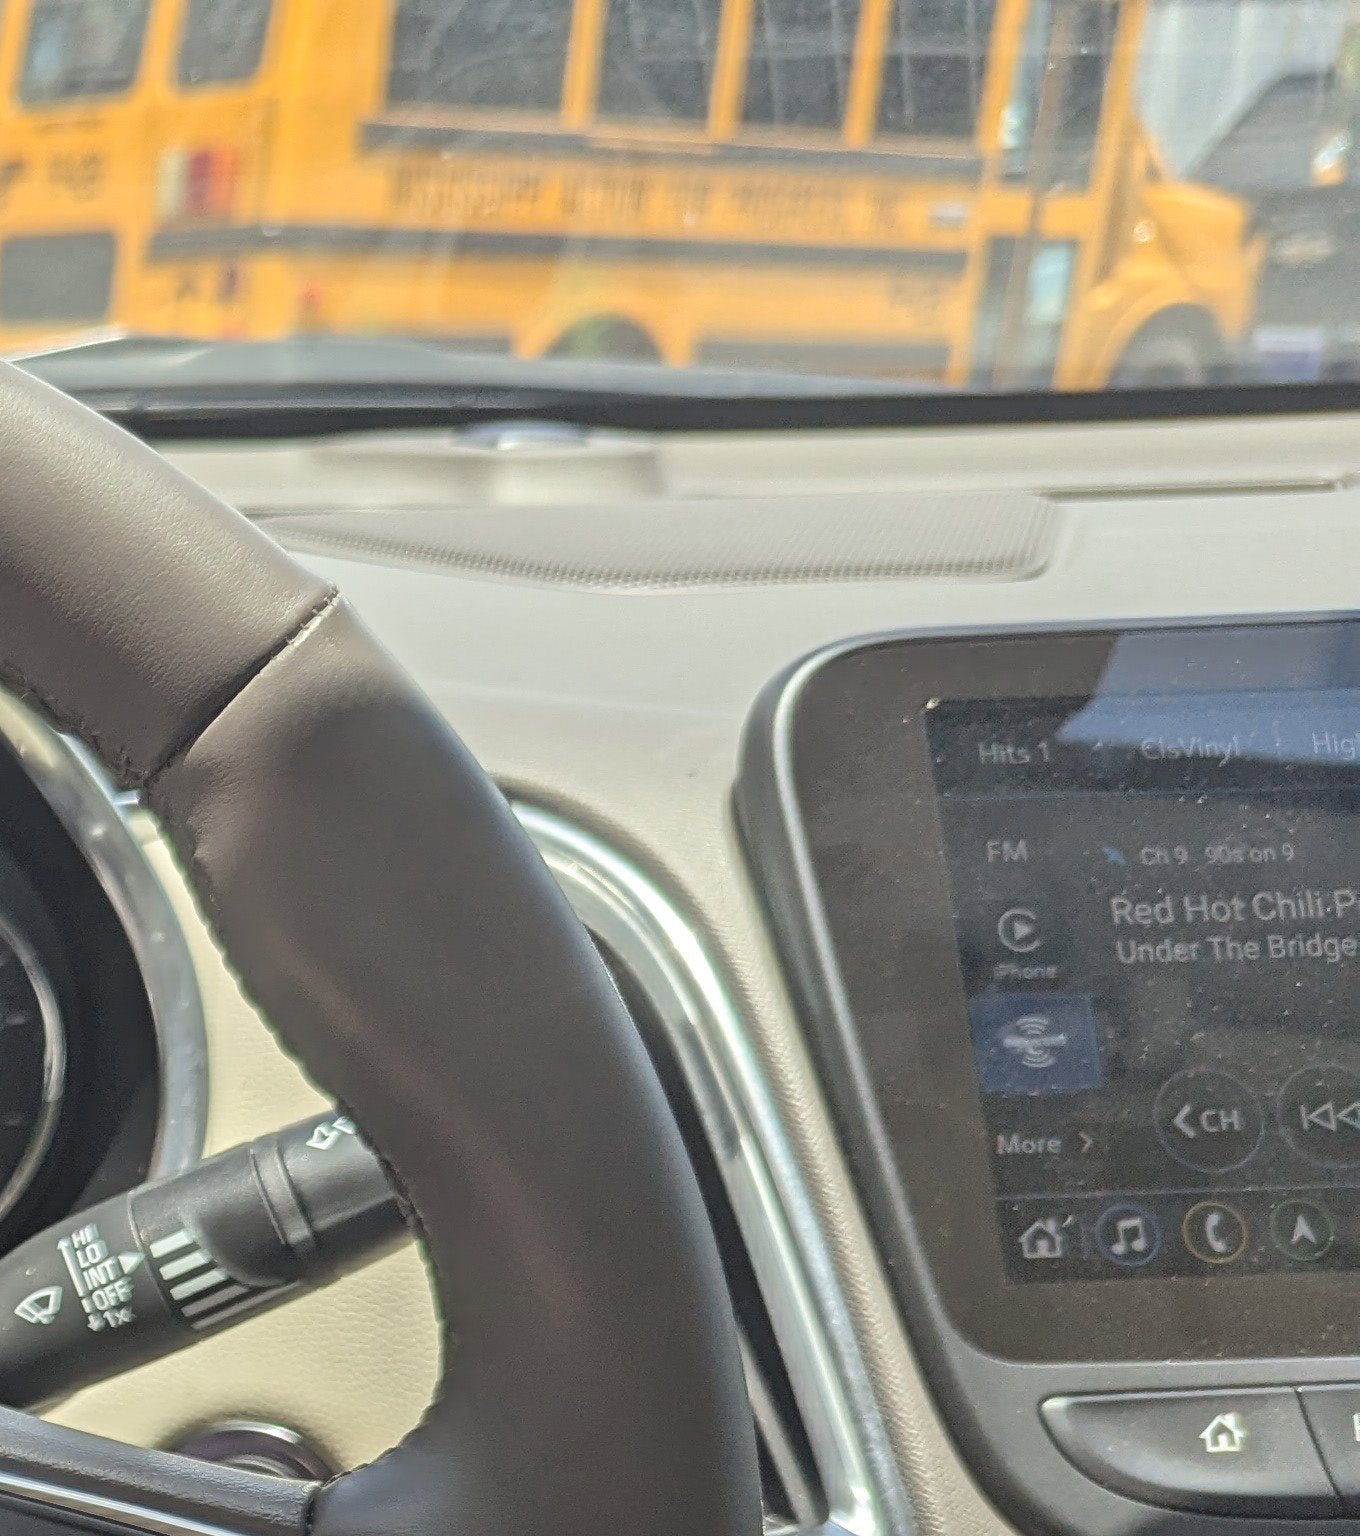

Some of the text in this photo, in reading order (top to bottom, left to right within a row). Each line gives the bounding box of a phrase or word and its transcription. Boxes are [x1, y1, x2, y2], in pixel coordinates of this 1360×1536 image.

[978, 741, 1030, 764] Hits
[986, 839, 1028, 864] FM
[1110, 896, 1175, 925] Red
[1183, 896, 1246, 923] Hot
[1251, 887, 1326, 921] Chili
[1115, 931, 1359, 964] Under The Bridge
[1199, 1109, 1242, 1133] CH
[996, 1134, 1062, 1155] More
[76, 1240, 108, 1269] LO
[82, 1256, 122, 1291] INT
[91, 1276, 135, 1311] OFF
